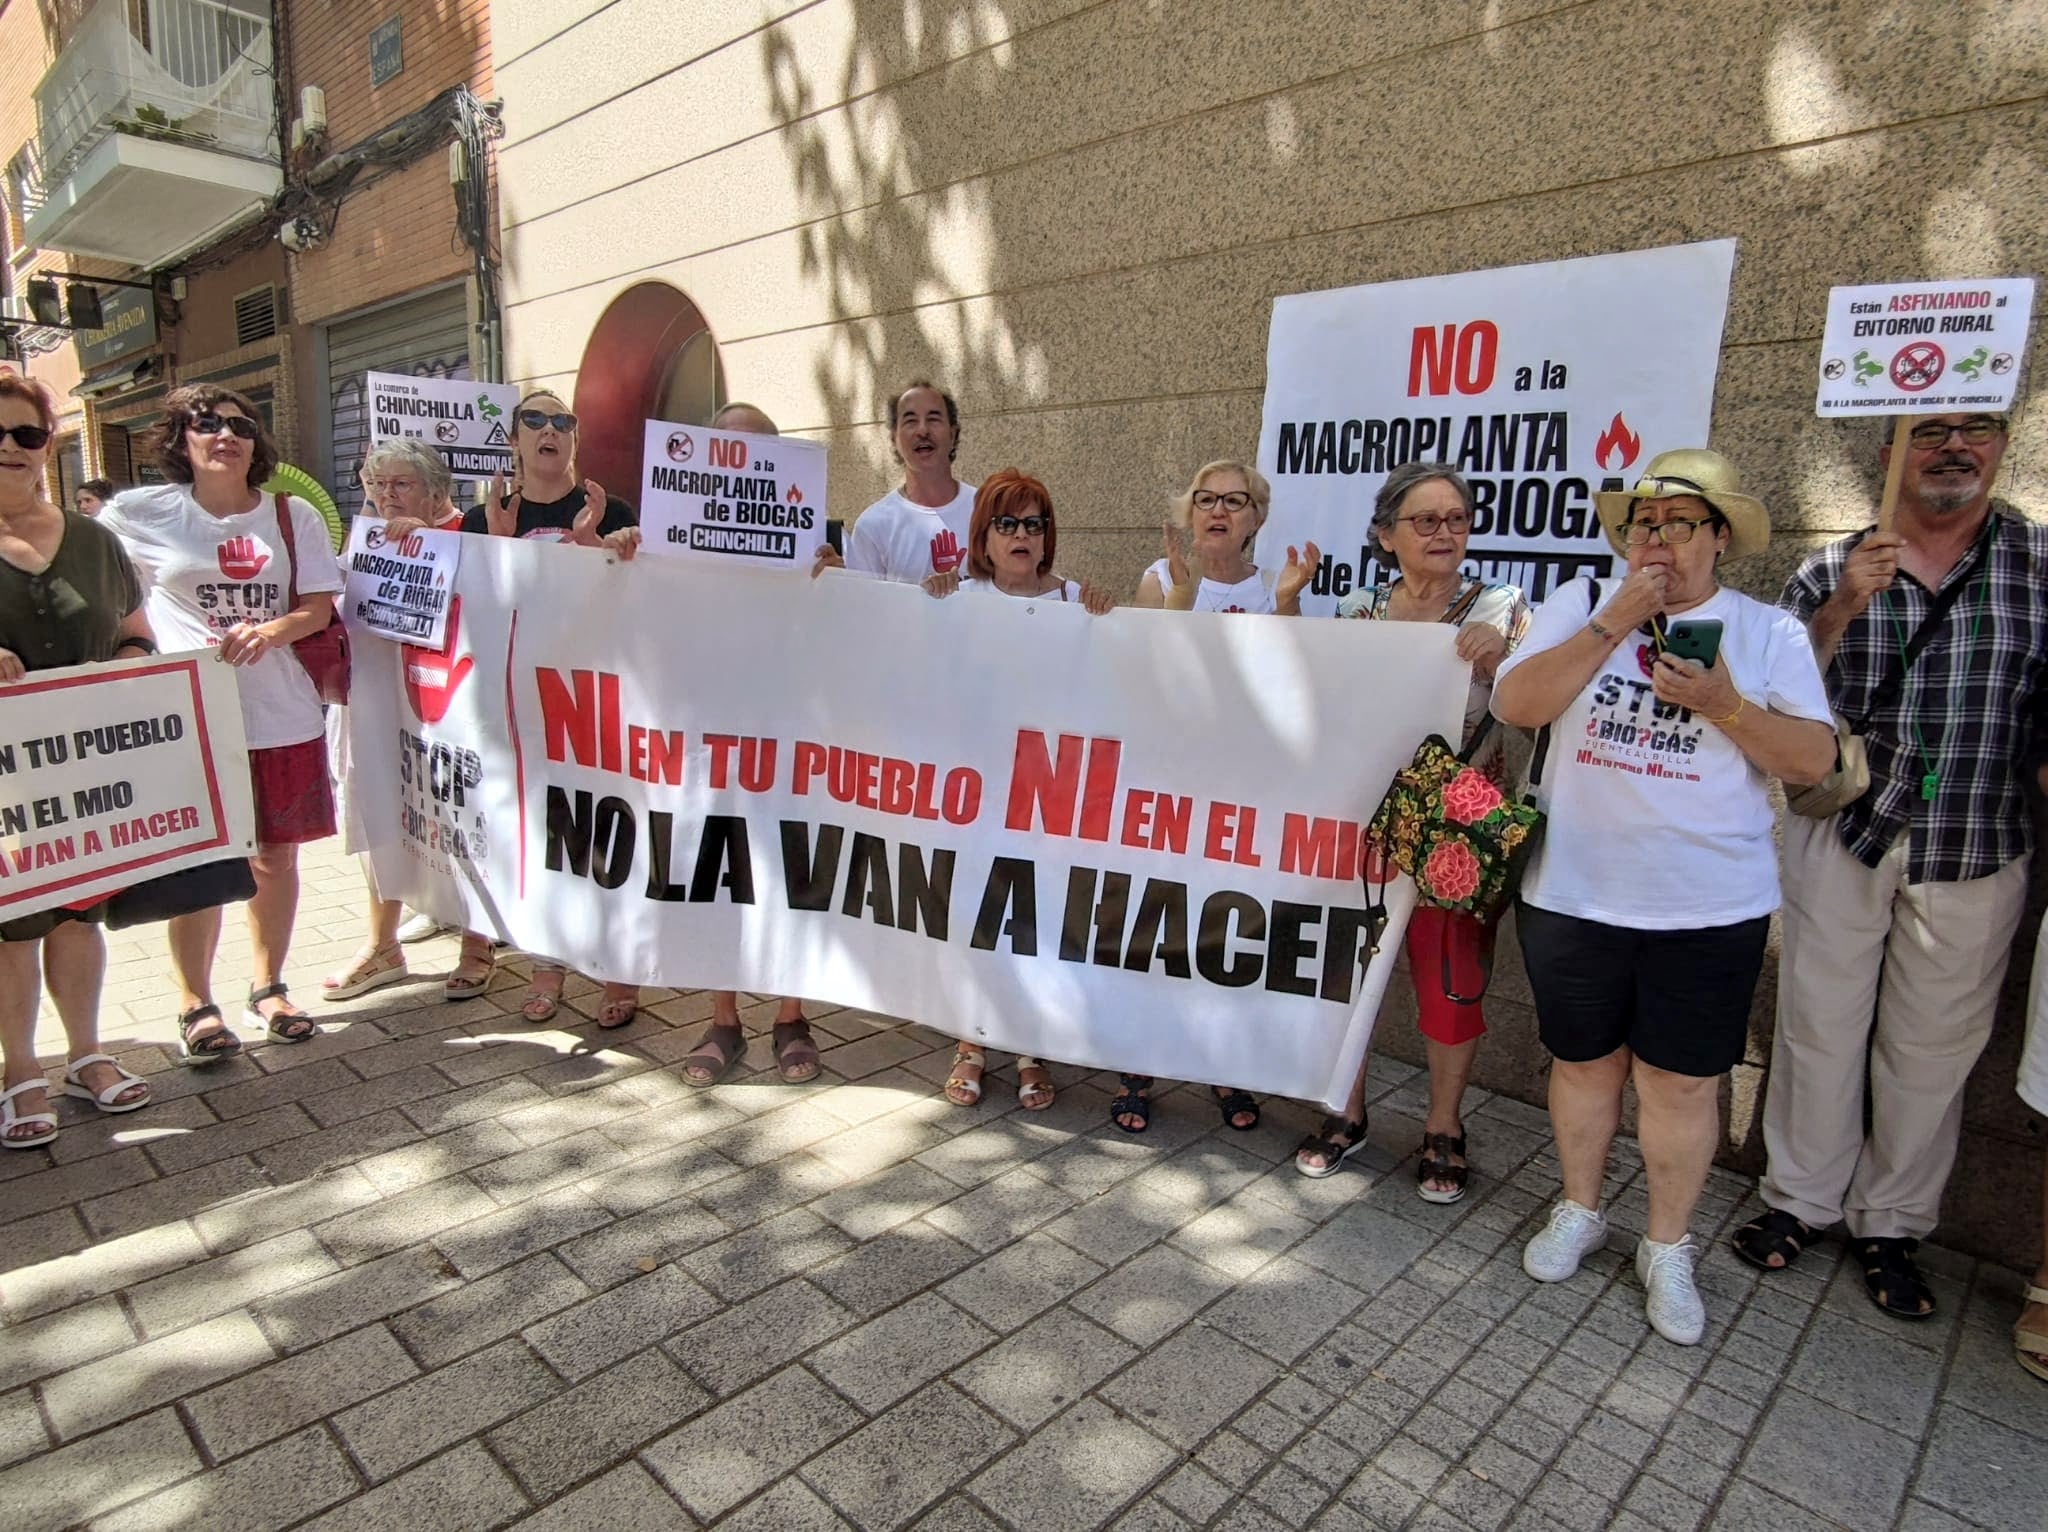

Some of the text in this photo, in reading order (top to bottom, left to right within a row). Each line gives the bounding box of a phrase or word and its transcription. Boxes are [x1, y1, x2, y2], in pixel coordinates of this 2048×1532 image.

[1850, 290, 2008, 314] Están ASFIXIANDO al
[1853, 314, 1994, 337] ENTORNO RURAL
[1407, 319, 1567, 398] NO a la
[383, 383, 410, 395] comarca
[411, 385, 419, 396] de
[1840, 399, 1850, 408] LA
[376, 394, 475, 421] CHINCHILLA
[377, 416, 401, 436] NO
[452, 452, 515, 472] NACIONAL
[708, 437, 775, 472] NO a la
[651, 465, 777, 502] MACROPLANTA
[703, 499, 814, 529] de BIOGAS
[1470, 477, 1640, 539] BIOG
[396, 535, 424, 559] NO
[667, 525, 792, 556] de CHINCHILLA
[352, 552, 433, 586] MACROPLANTA
[1312, 553, 1351, 598] de
[195, 582, 279, 609] STOP
[377, 580, 446, 614] de BIOGAS
[1594, 673, 1694, 724] ST
[22, 734, 68, 769] TU
[73, 713, 184, 760] PUEBLO
[1585, 739, 1692, 765] FUENTEALBILLA
[1586, 717, 1698, 755] ¿BIO?GAS
[399, 728, 484, 808] STOP
[535, 666, 622, 774] NI
[628, 724, 684, 786] EN
[702, 733, 778, 793] TU
[791, 740, 983, 825] PUEBLO
[1004, 728, 1122, 842] NI
[1120, 788, 1193, 855] EN
[1203, 800, 1262, 868] EL
[1576, 750, 1592, 765] NI
[1646, 763, 1664, 778] NI
[32, 796, 69, 829] EL
[73, 781, 133, 819] MIO
[11, 836, 76, 874] VAN
[83, 830, 104, 856] A
[109, 806, 200, 849] HACER
[545, 784, 1389, 1004] NO LA VAN A HACER
